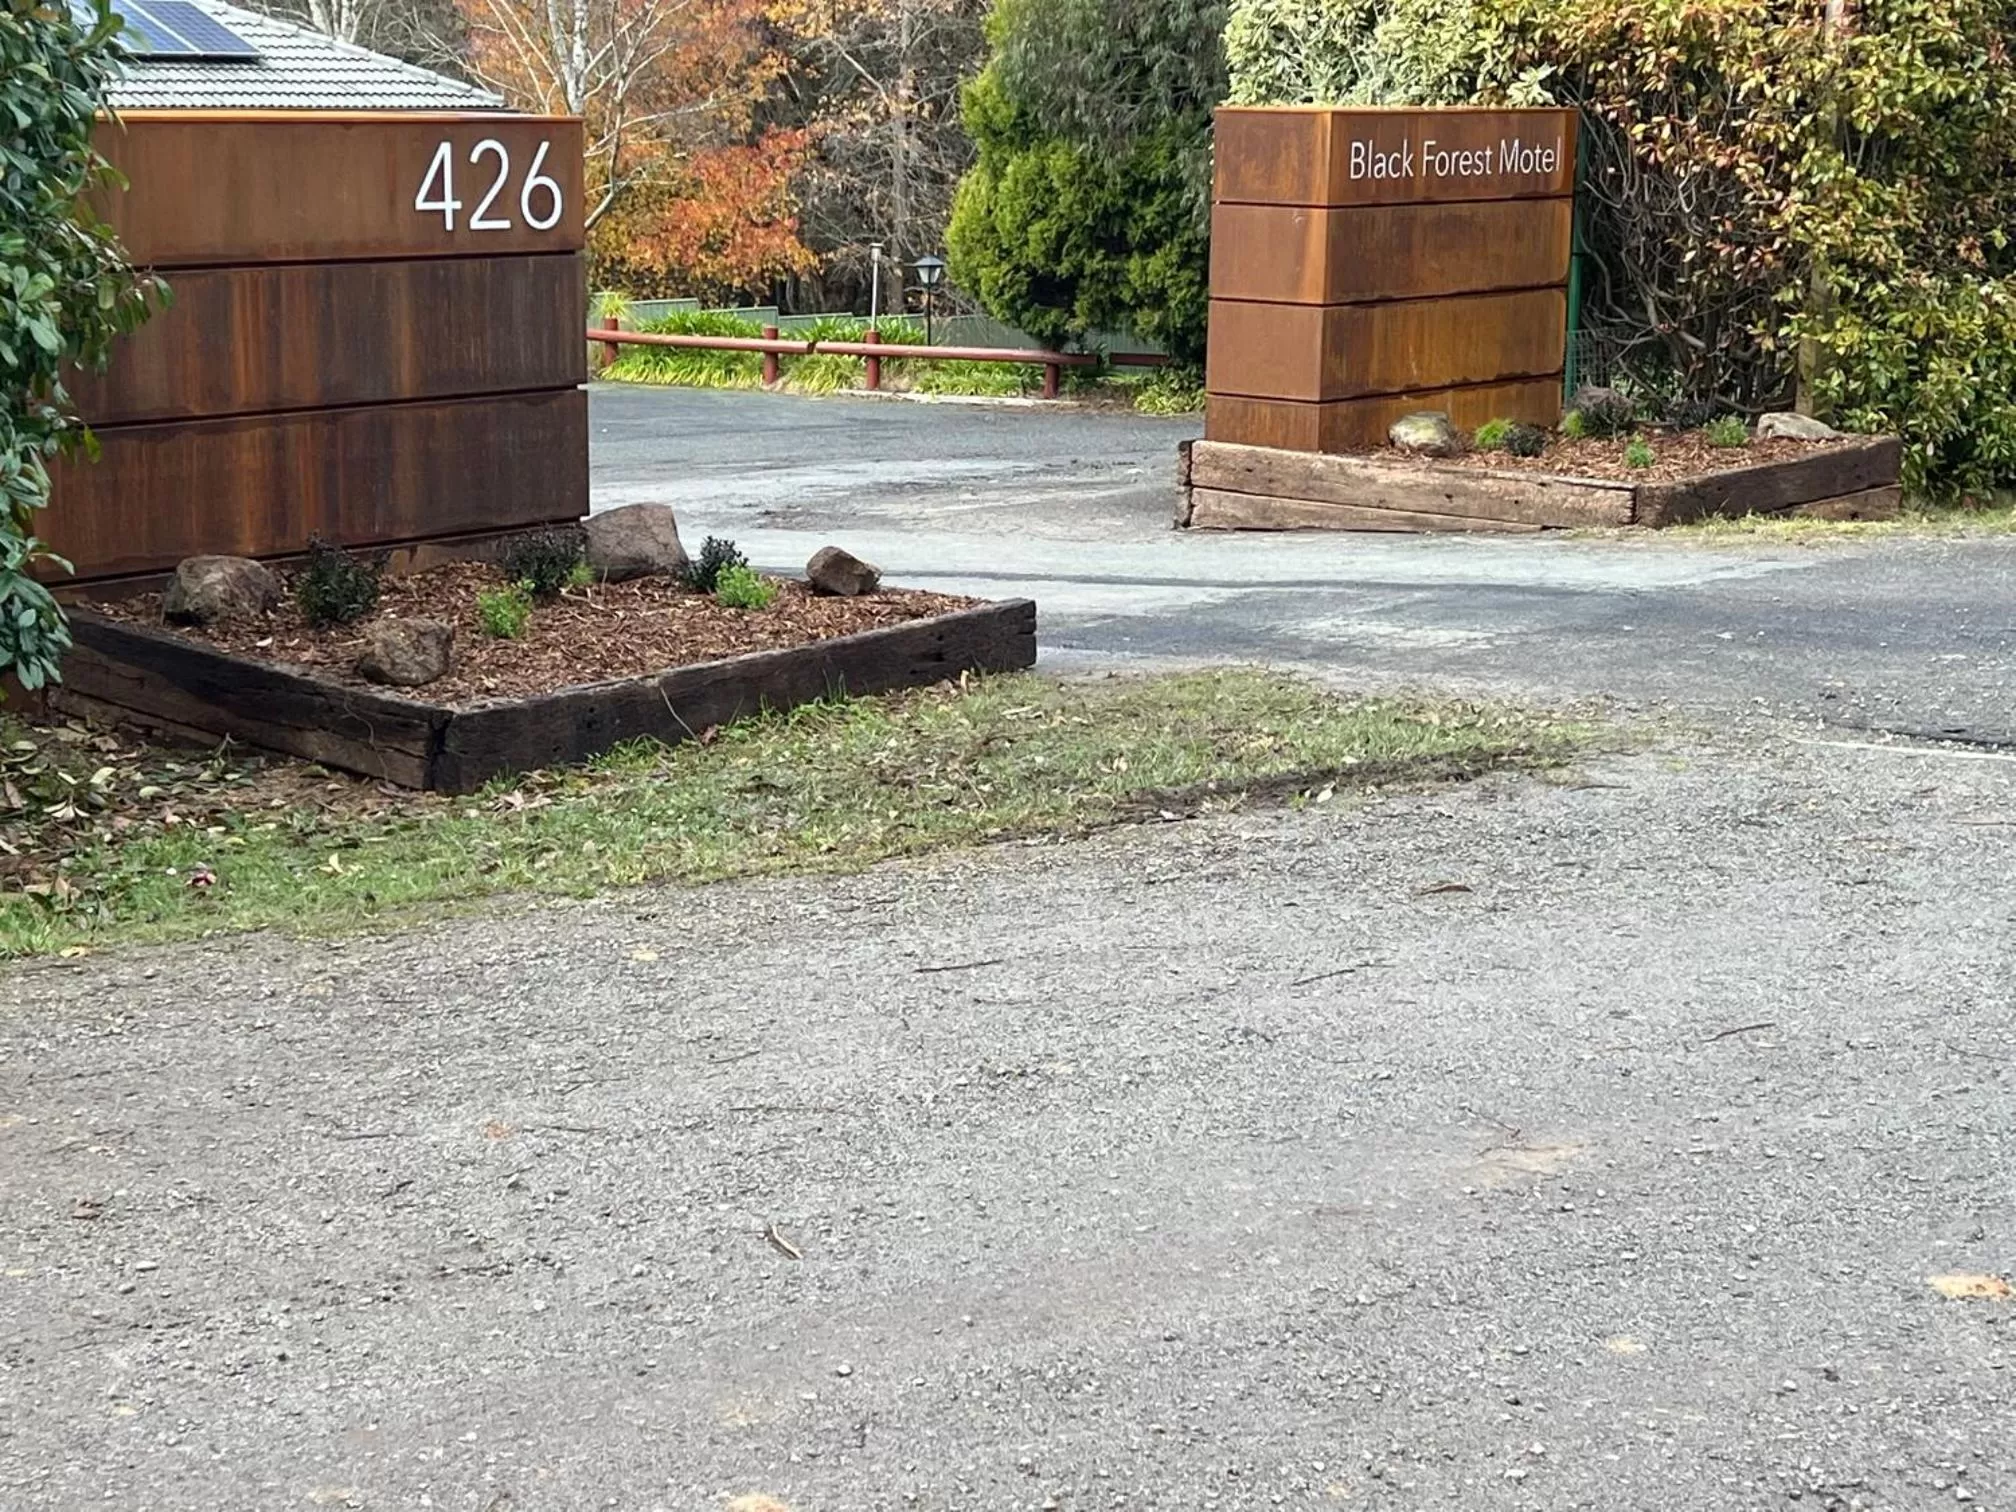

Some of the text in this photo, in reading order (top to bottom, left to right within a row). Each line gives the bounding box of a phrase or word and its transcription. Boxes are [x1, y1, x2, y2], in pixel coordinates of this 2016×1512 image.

[415, 139, 563, 231] 426
[1350, 136, 1561, 179] Black Forest Motel
